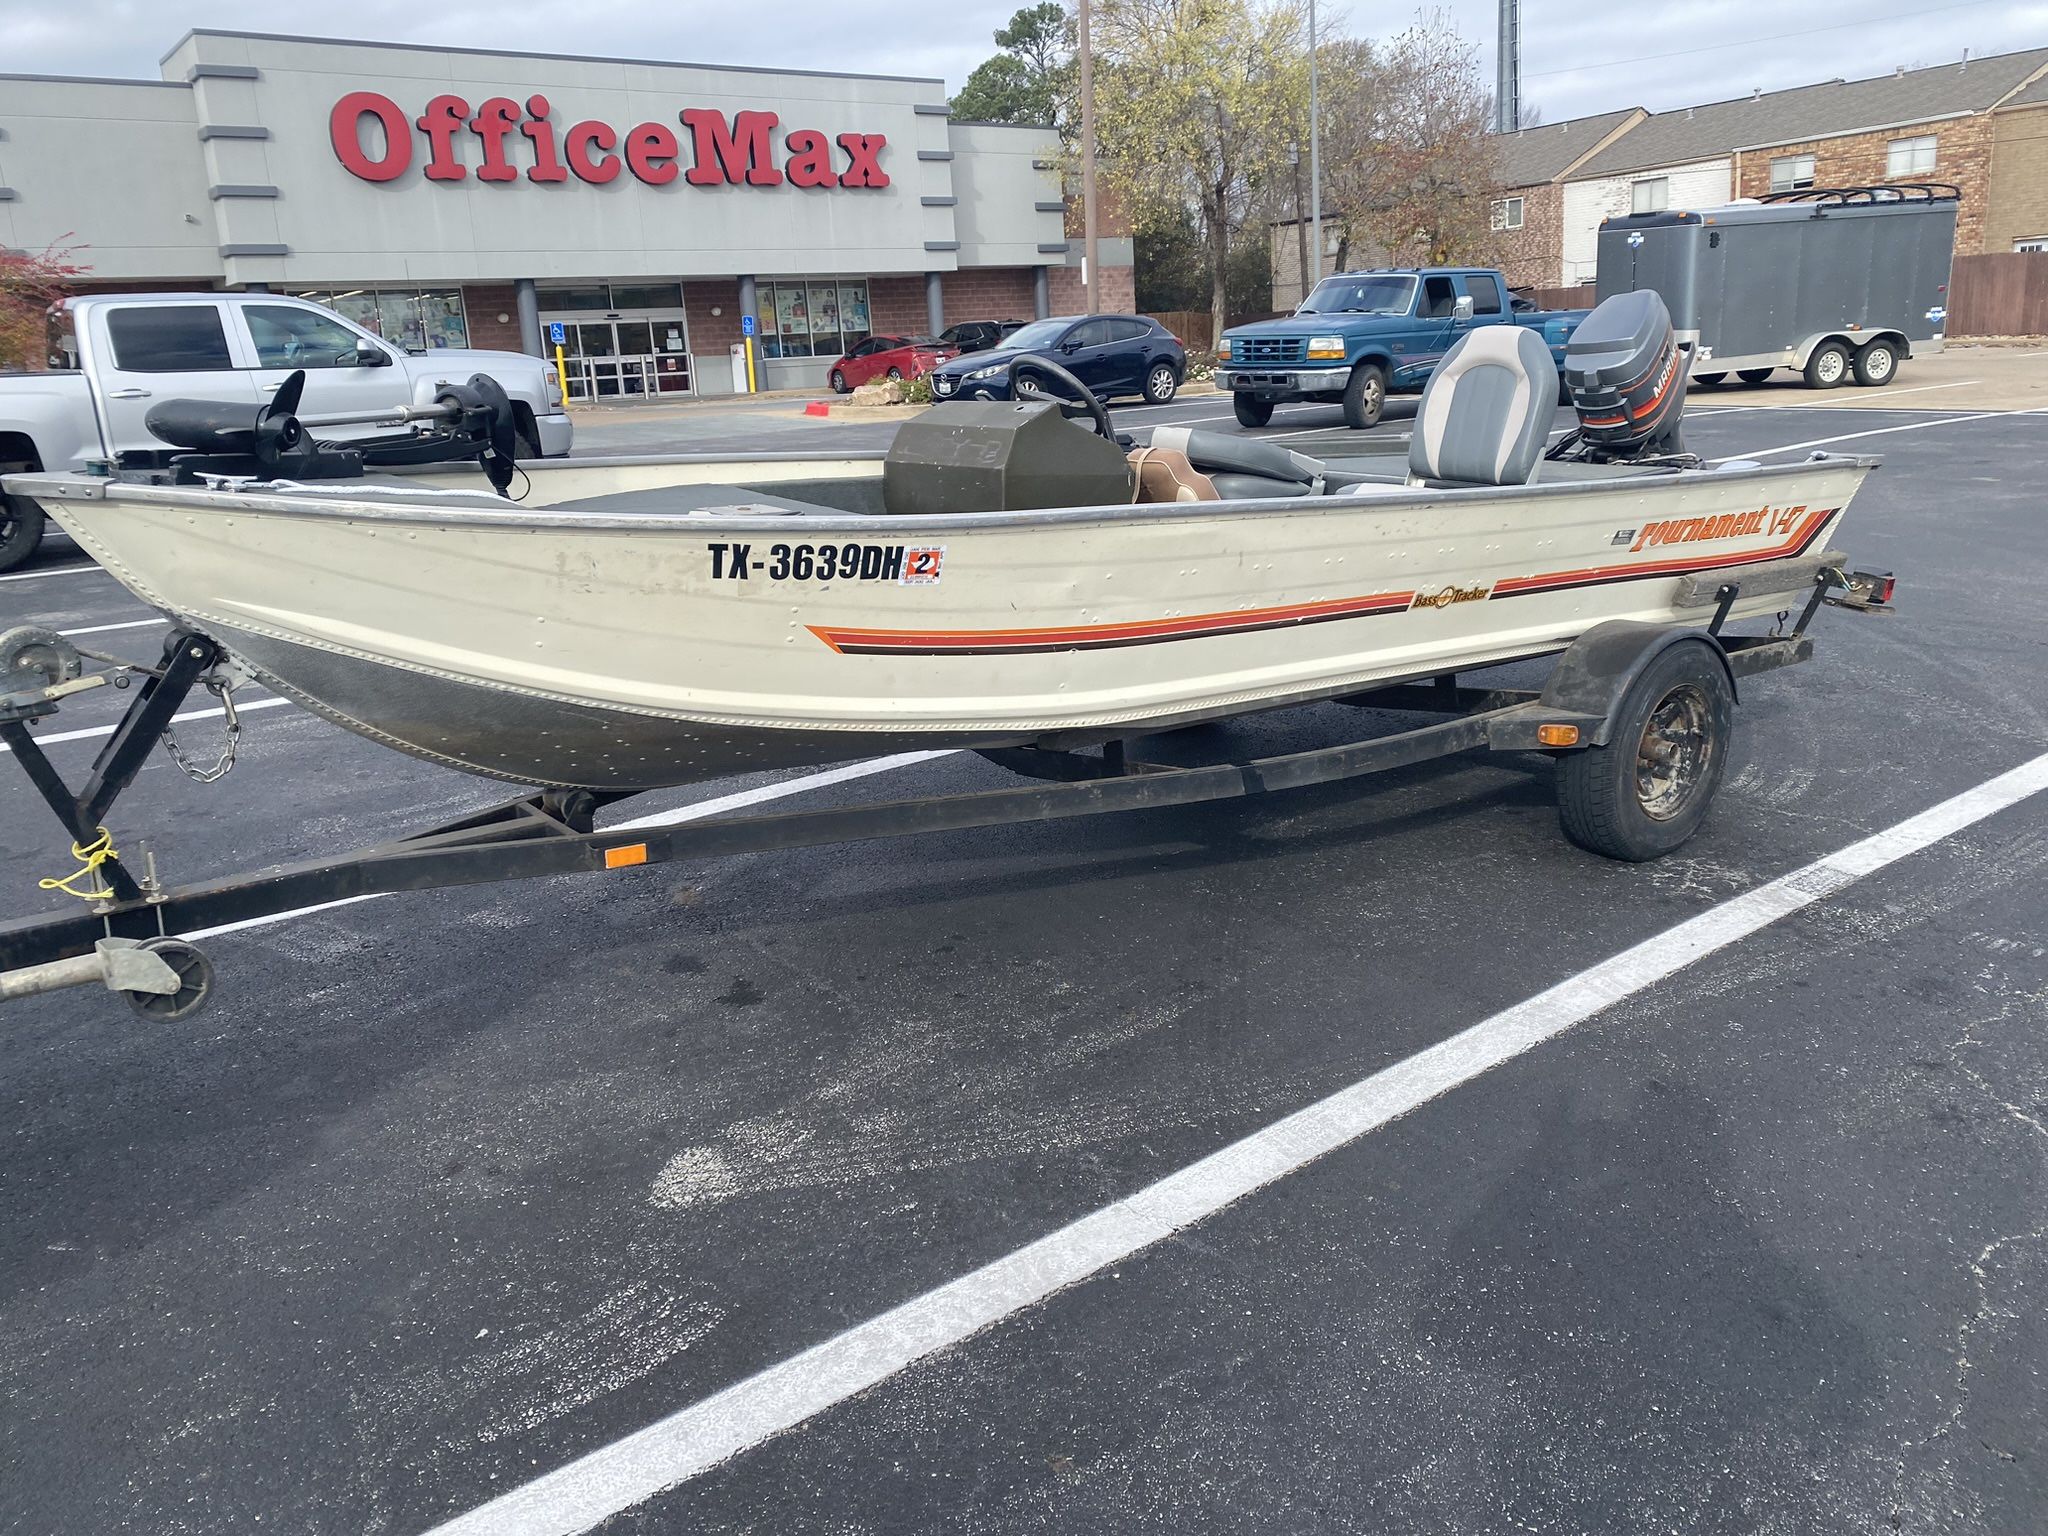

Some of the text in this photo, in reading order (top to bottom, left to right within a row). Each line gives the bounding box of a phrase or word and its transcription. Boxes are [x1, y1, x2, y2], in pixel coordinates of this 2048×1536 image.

[329, 90, 890, 188] OfficeMax
[1629, 505, 1769, 552] Tournament
[708, 543, 904, 580] TX-3639DH
[914, 553, 931, 574] 2
[1411, 586, 1490, 608] Bass Tracker
